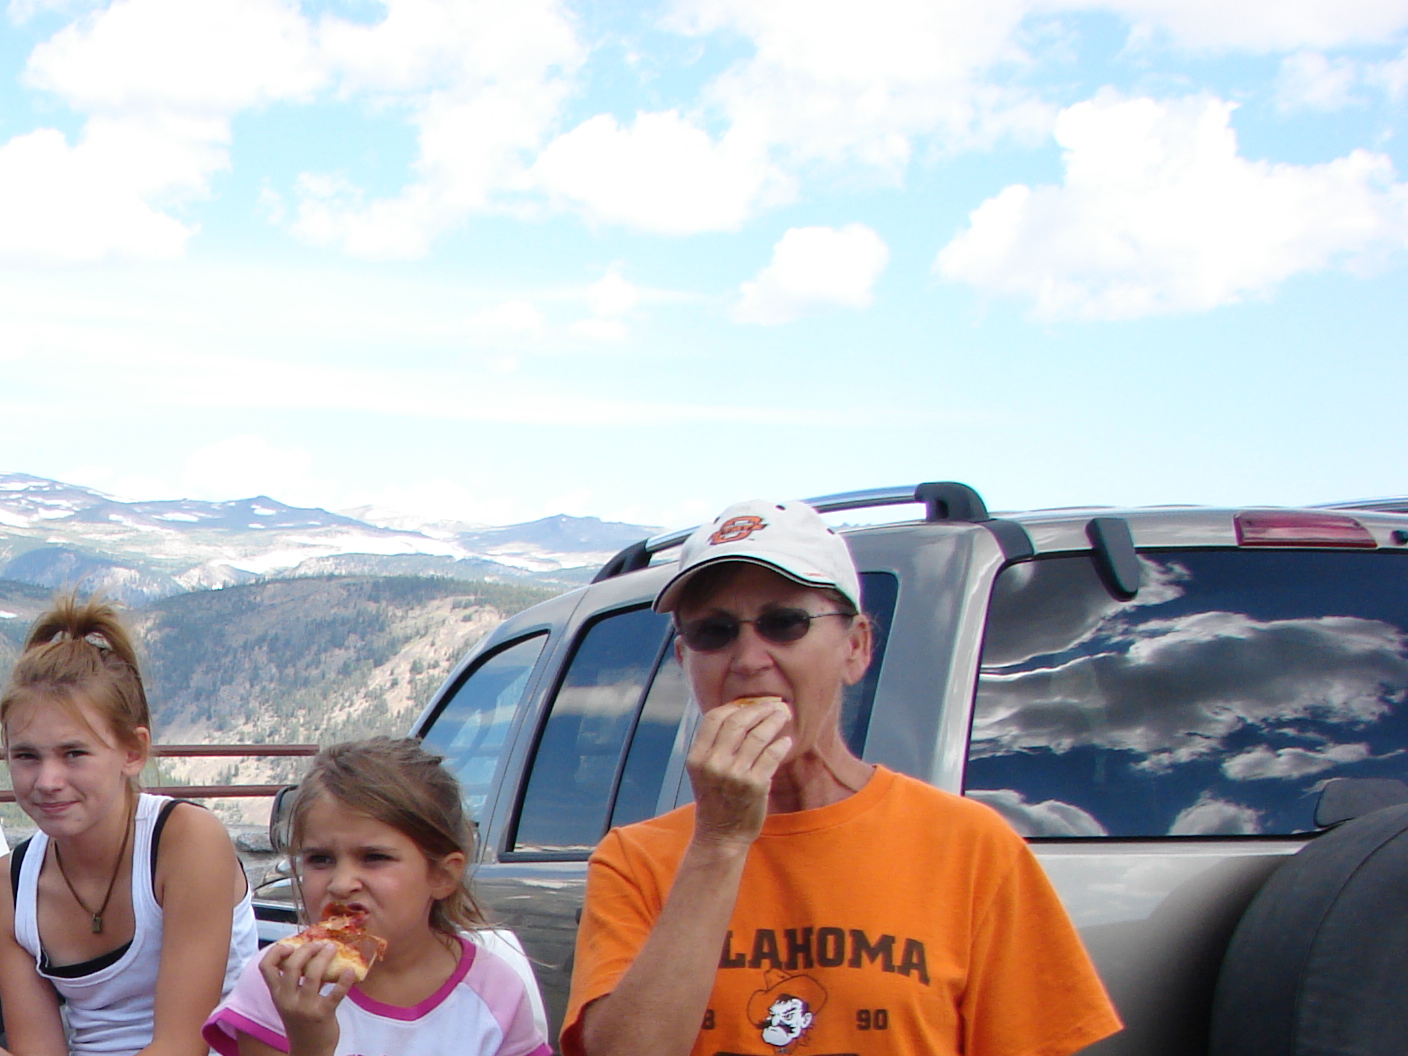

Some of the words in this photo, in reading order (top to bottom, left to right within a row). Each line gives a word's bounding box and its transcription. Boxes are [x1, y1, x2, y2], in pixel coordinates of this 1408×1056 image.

[719, 926, 930, 986] LAHOMA
[701, 1009, 715, 1031] 8
[856, 1009, 889, 1031] 90
